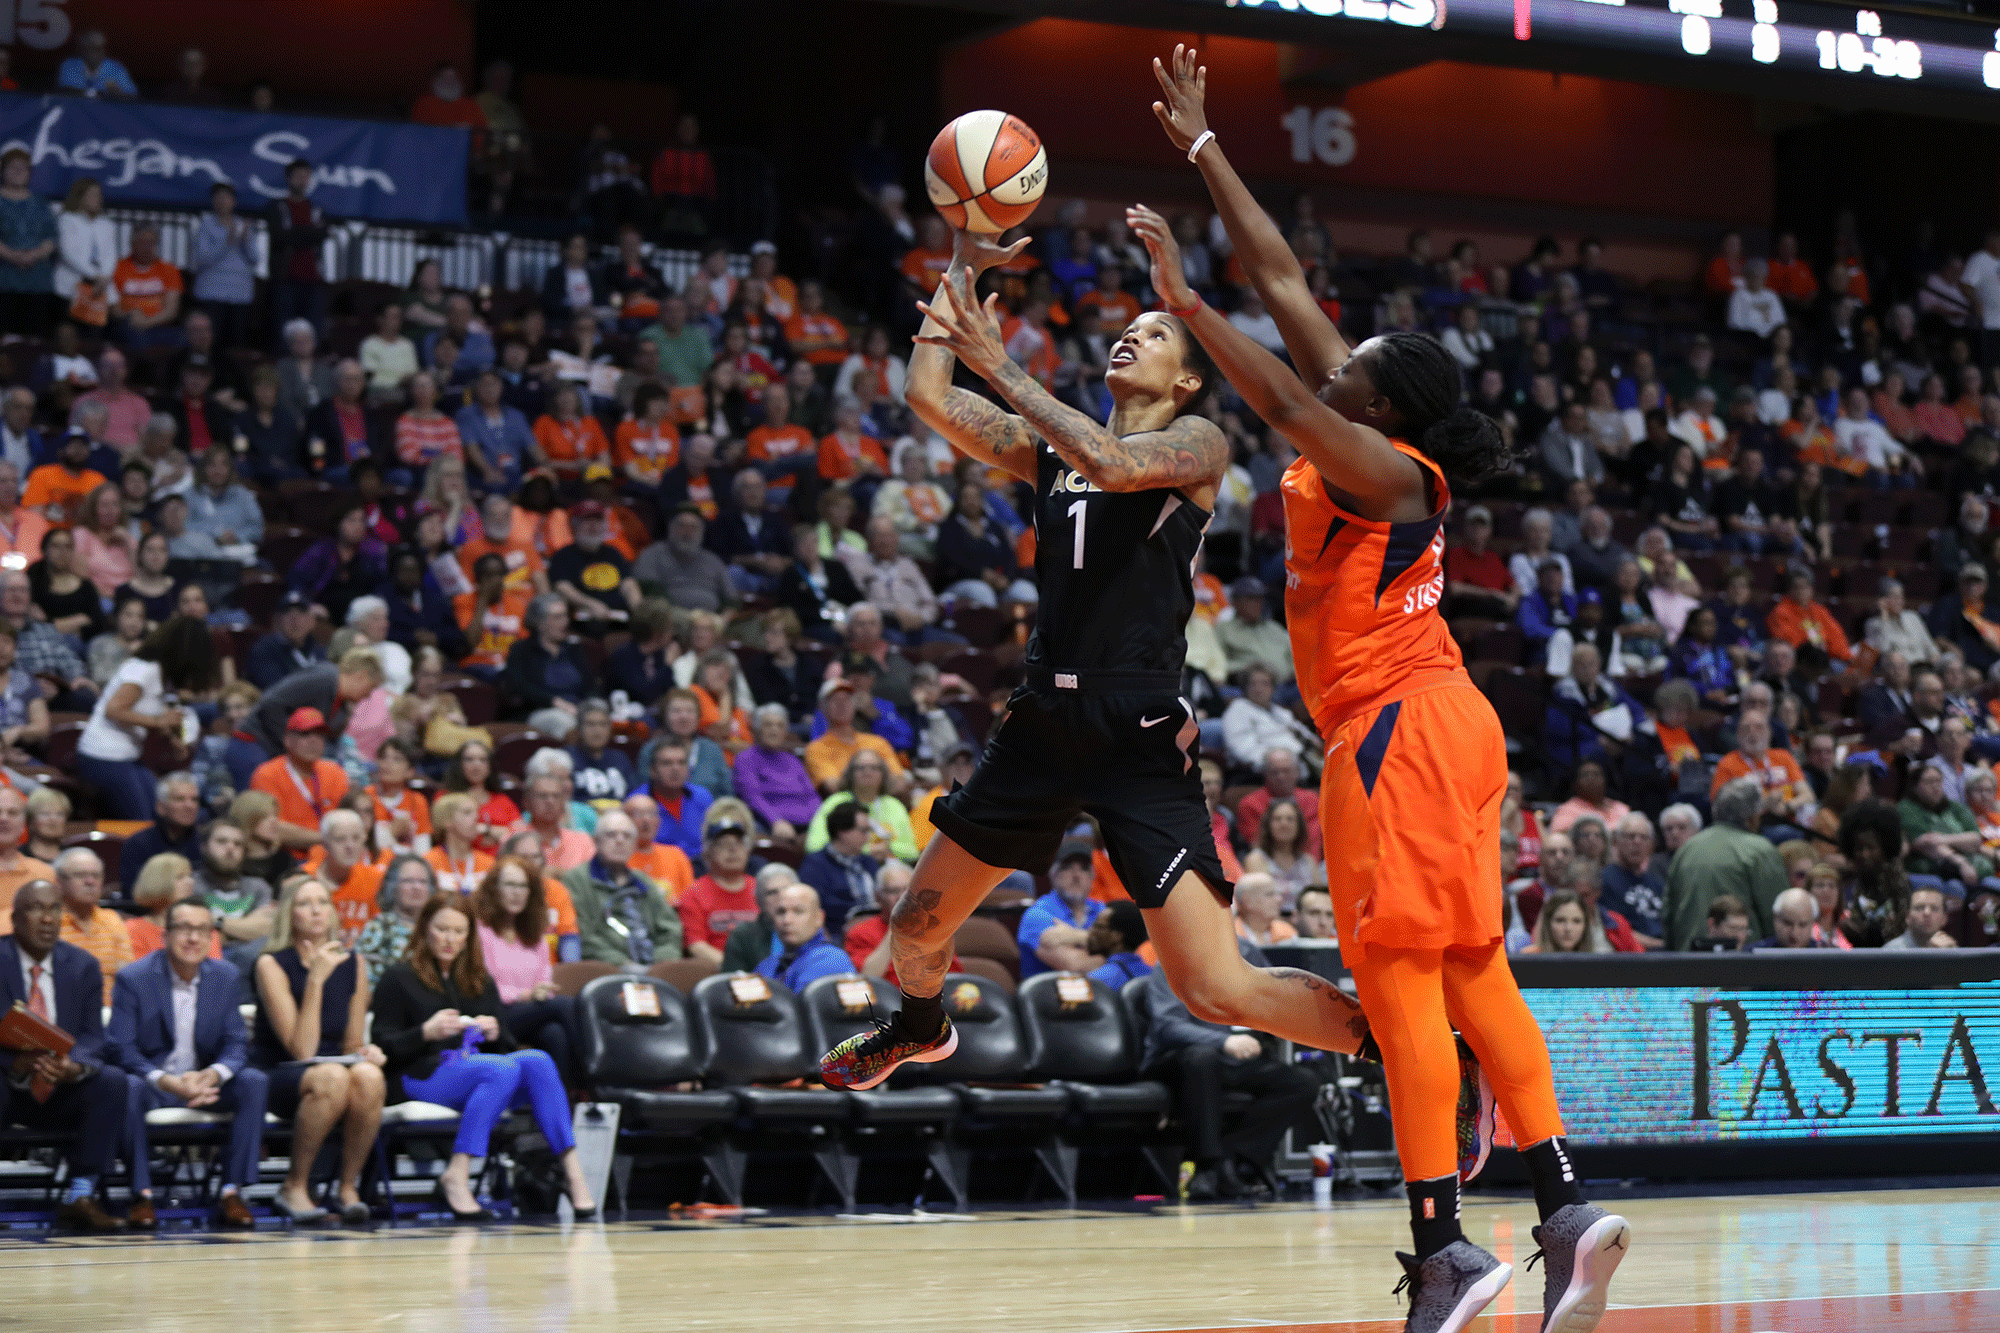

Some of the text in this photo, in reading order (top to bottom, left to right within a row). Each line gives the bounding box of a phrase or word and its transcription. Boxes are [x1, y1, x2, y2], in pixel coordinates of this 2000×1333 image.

[249, 131, 396, 198] Sun
[1281, 106, 1358, 166] 16
[1067, 500, 1087, 569] 1
[1157, 848, 1187, 889] LAS VEGAS
[1688, 1000, 2000, 1121] PASTA
